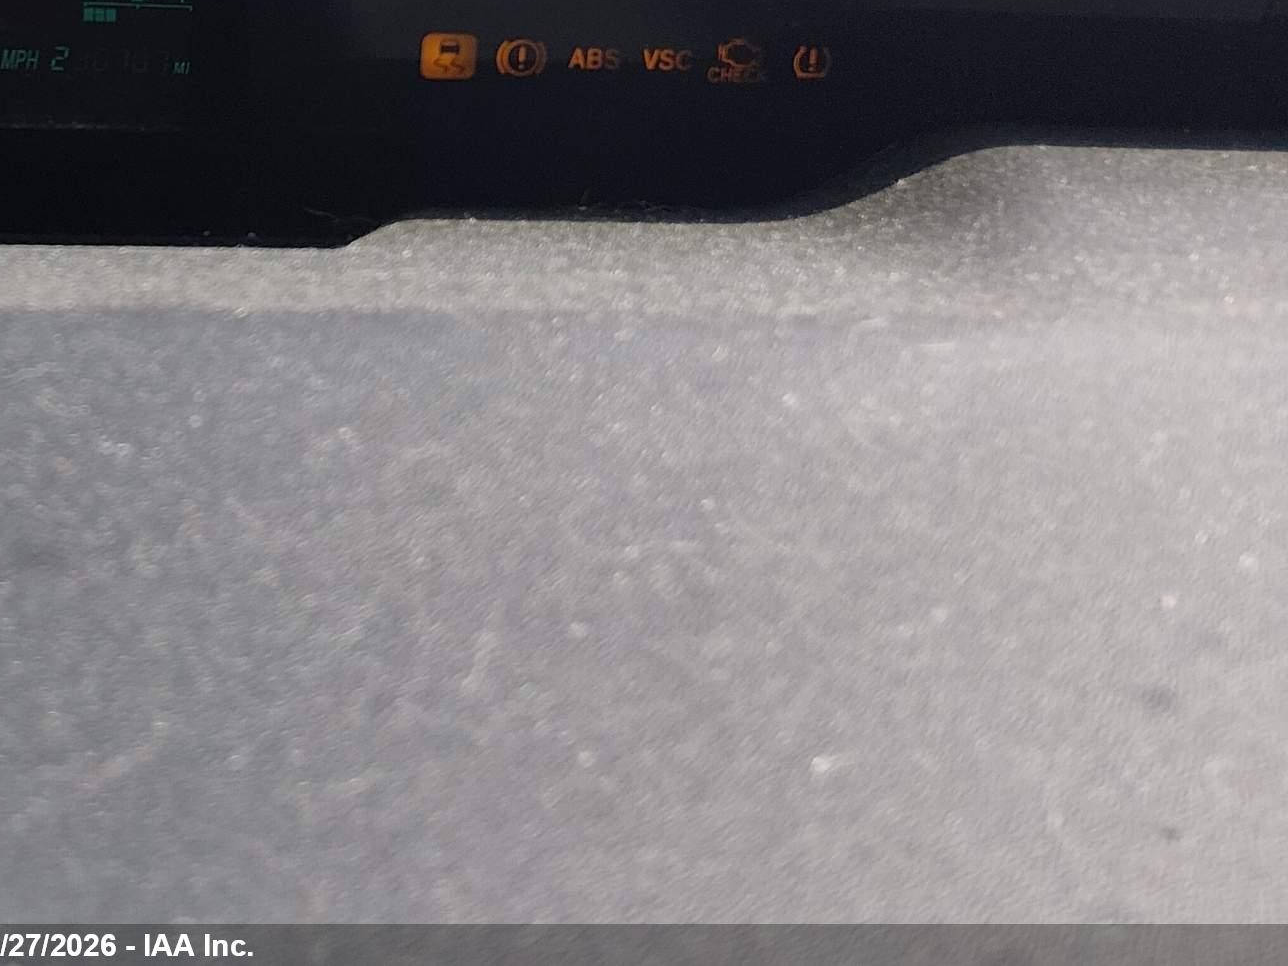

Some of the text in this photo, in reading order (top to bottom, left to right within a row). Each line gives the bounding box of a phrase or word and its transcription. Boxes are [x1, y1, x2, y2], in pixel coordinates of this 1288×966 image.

[0, 49, 40, 71] MPH
[568, 47, 619, 70] ABS
[643, 48, 693, 71] VSC
